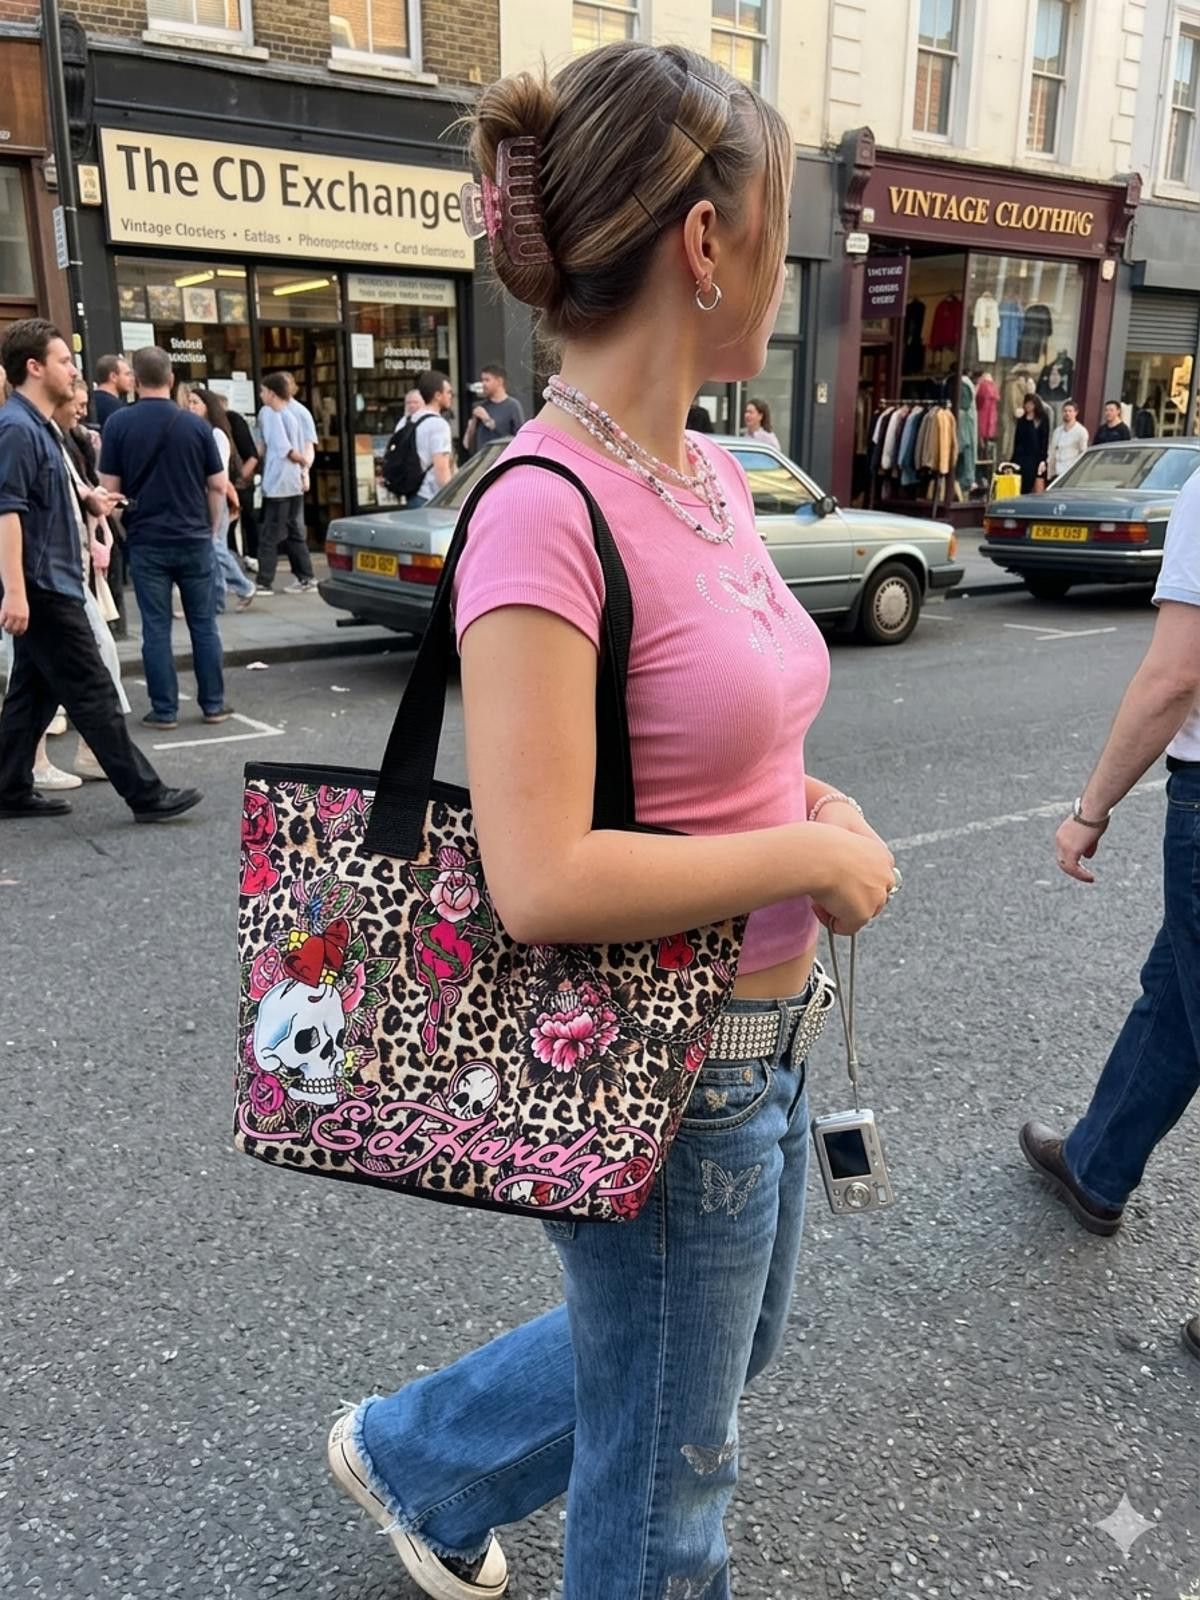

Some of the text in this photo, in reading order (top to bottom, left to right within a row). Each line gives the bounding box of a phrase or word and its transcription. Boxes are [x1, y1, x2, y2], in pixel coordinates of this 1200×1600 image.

[117, 144, 461, 230] The CD Exchange
[889, 186, 1094, 237] VINTAGE CLOTHING
[121, 218, 172, 238] Vintage
[310, 1099, 628, 1211] Ed Hardy
